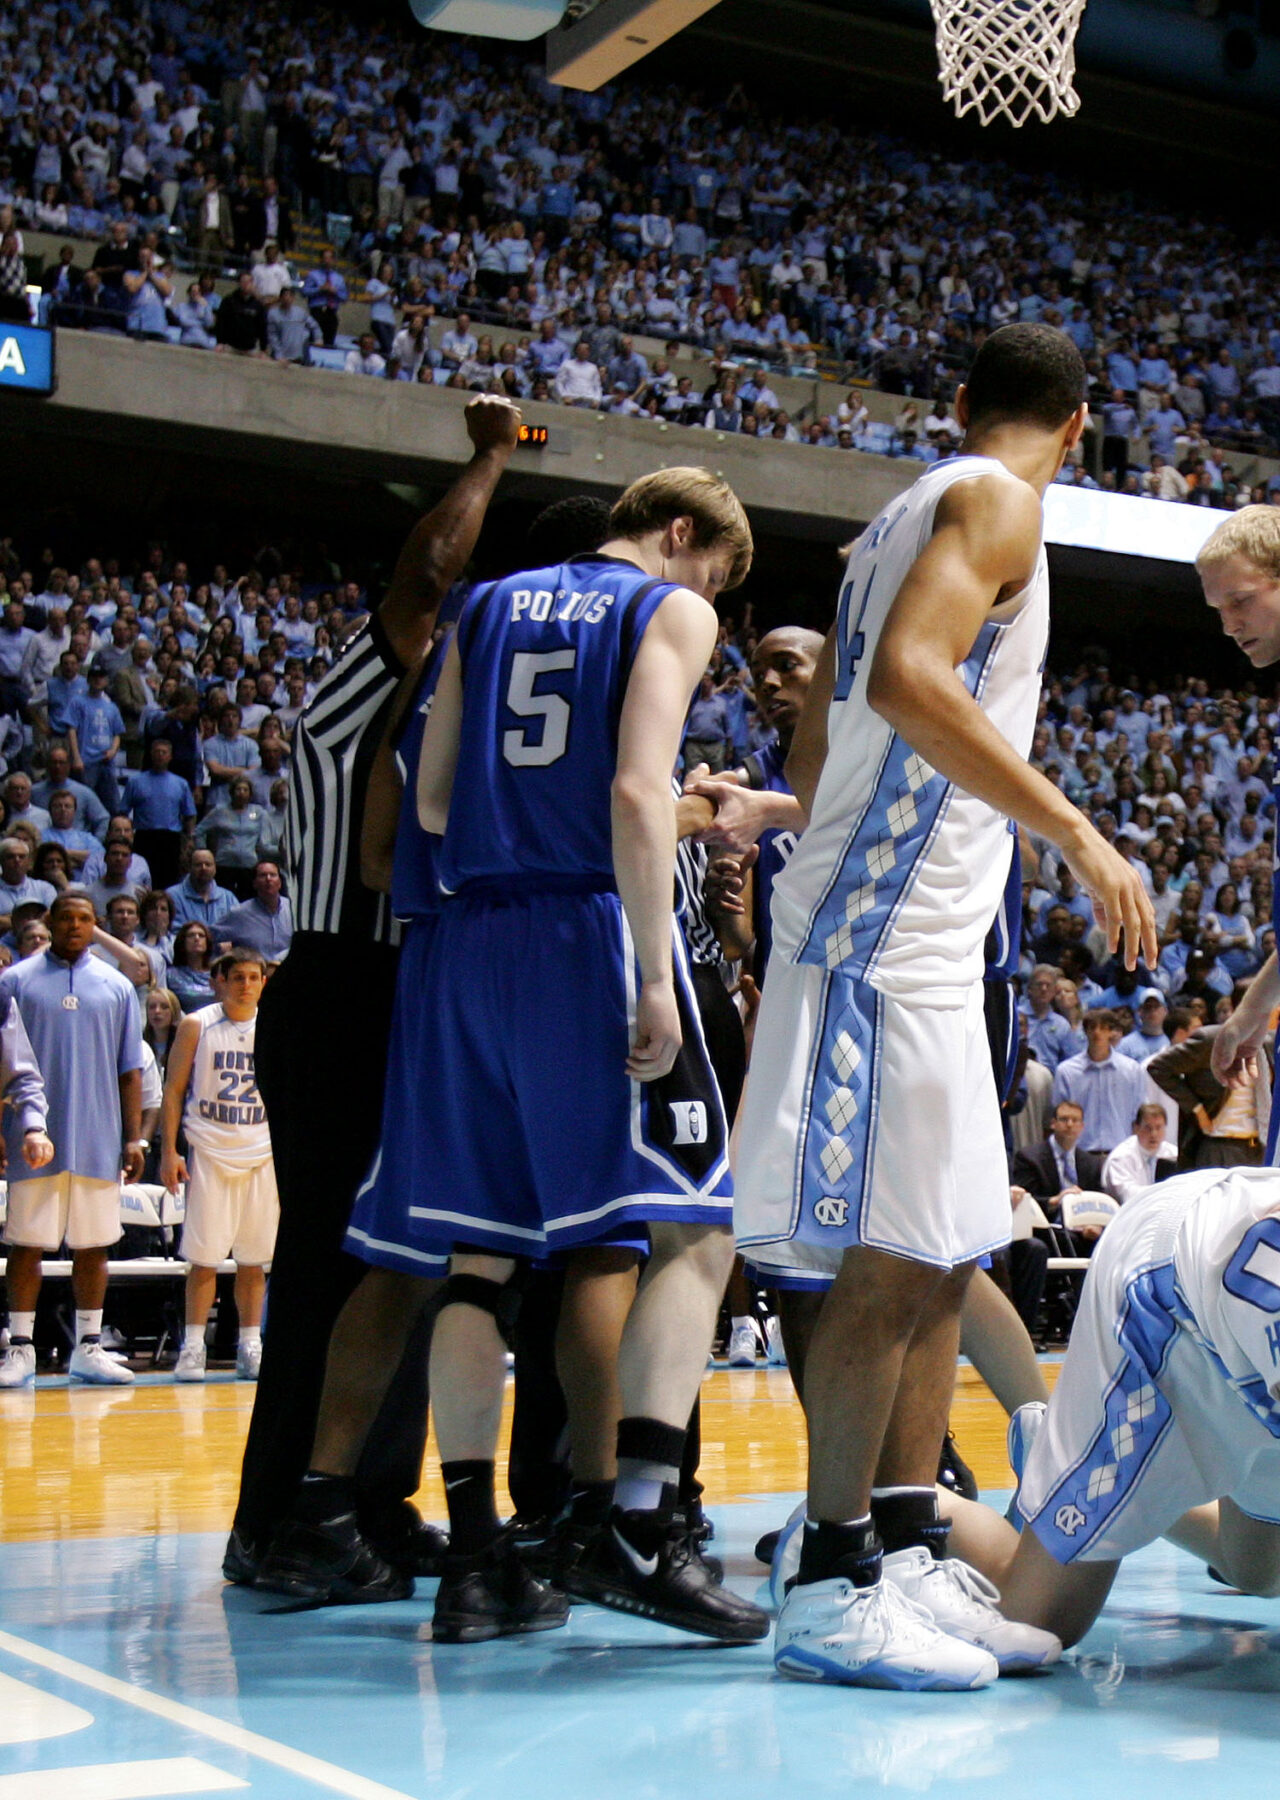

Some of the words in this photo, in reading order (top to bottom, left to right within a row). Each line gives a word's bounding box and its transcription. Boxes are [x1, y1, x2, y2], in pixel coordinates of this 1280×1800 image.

[503, 649, 576, 767] 5
[213, 1050, 256, 1071] NORT
[217, 1071, 258, 1103] 22
[199, 1100, 268, 1125] CAROLIN
